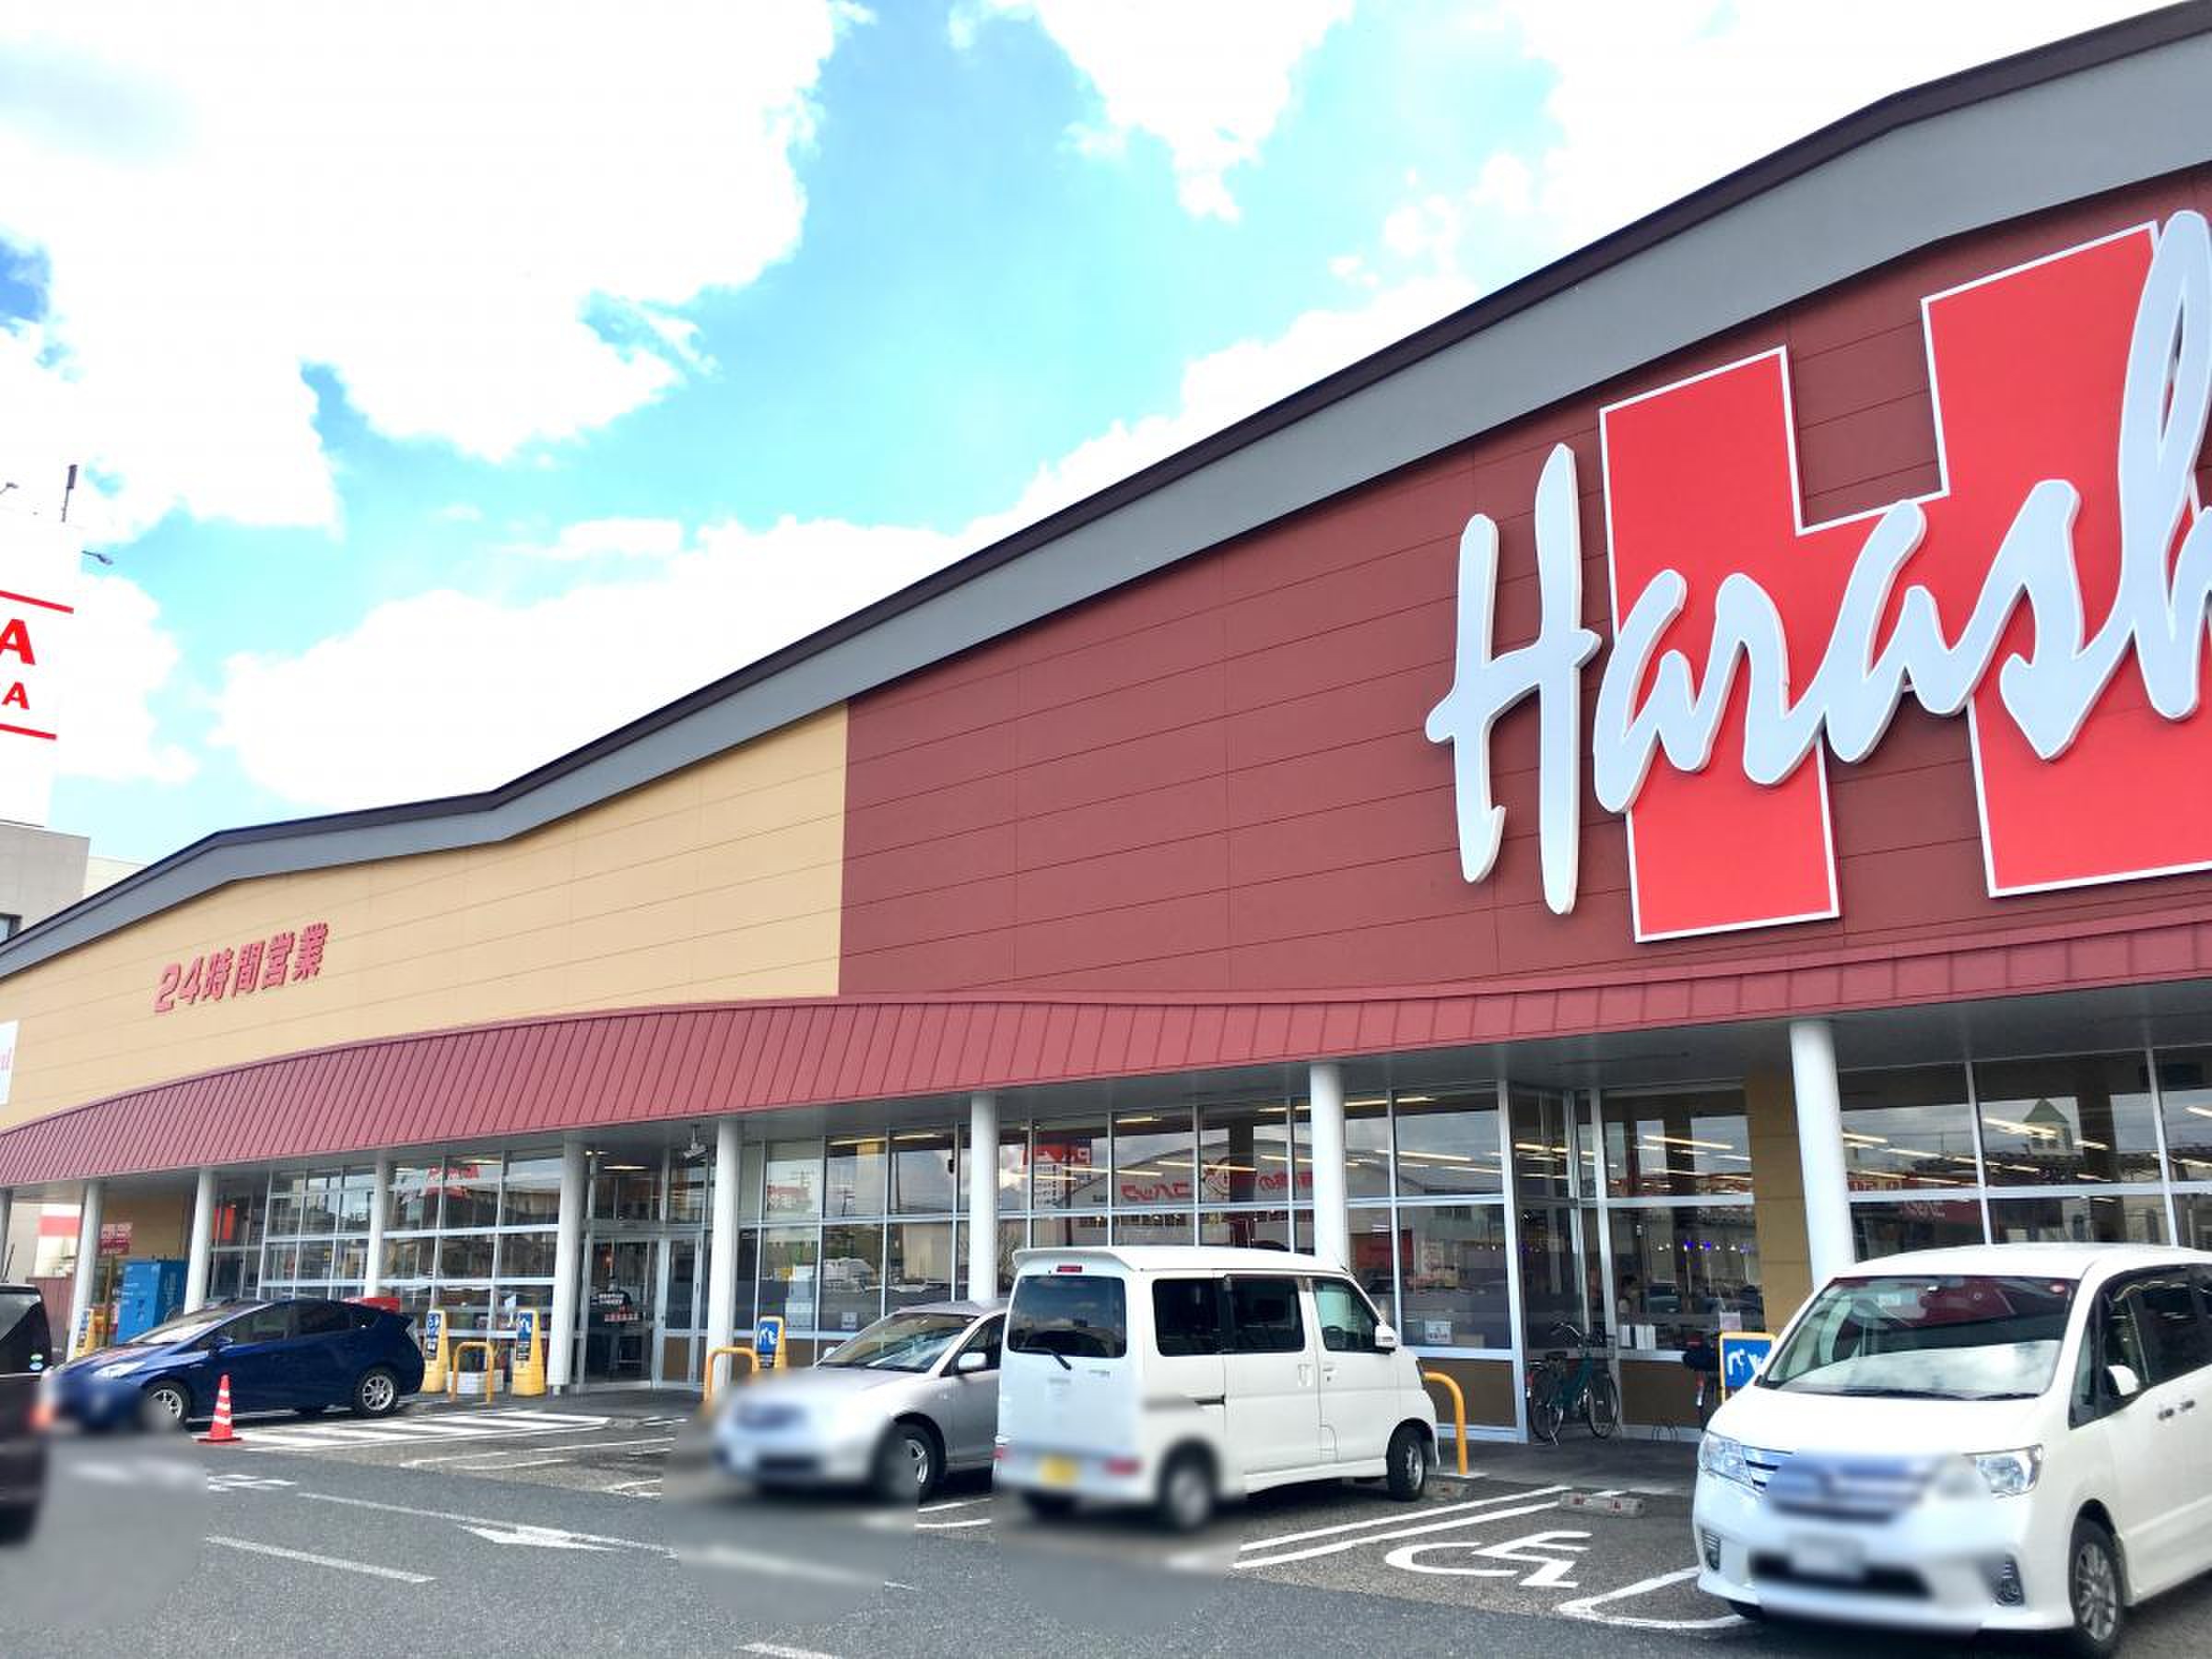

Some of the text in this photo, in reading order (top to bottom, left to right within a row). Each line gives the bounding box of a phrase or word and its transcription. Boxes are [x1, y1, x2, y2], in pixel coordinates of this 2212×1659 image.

[0, 618, 36, 666] A
[2, 682, 30, 711] A
[155, 922, 329, 1013] 24時間営業
